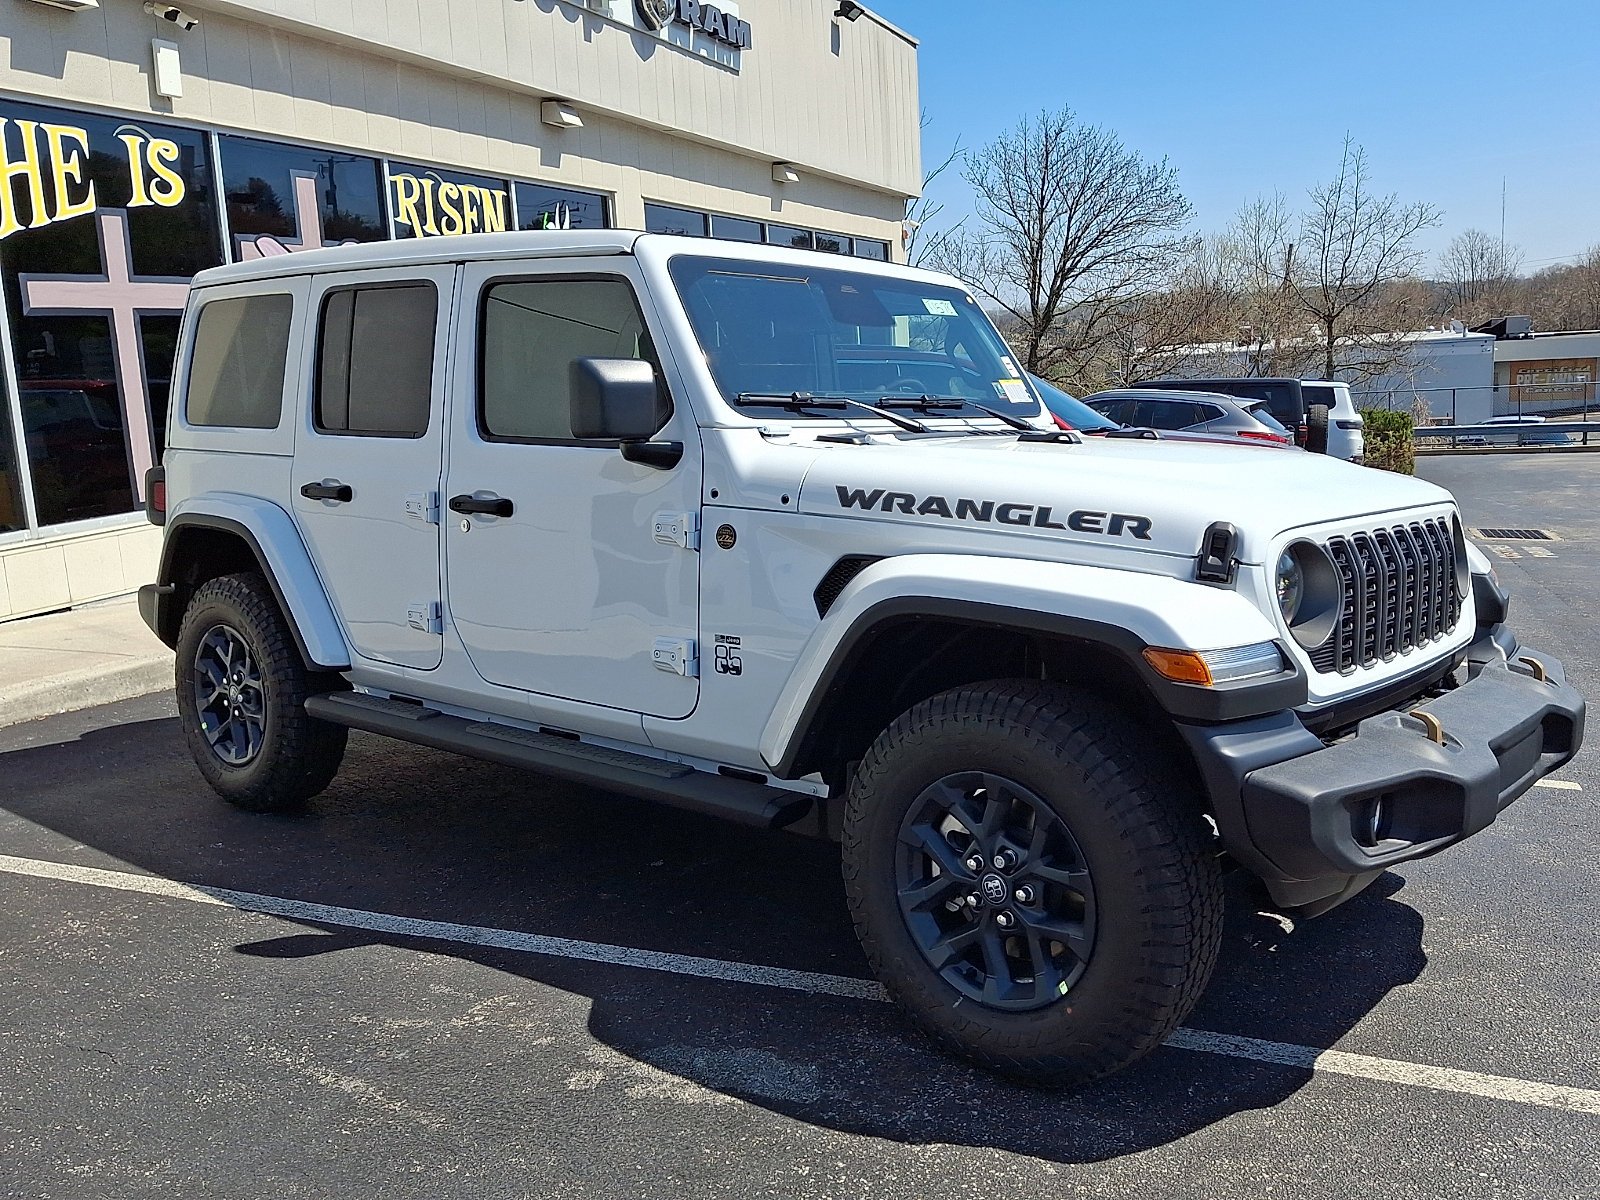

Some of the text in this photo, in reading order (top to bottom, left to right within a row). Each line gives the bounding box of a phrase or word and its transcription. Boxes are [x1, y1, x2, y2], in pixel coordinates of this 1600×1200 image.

[678, 0, 752, 50] RAM
[0, 117, 507, 239] HE IS RISEN
[835, 484, 1152, 541] WRANGLER
[715, 644, 743, 676] 85
